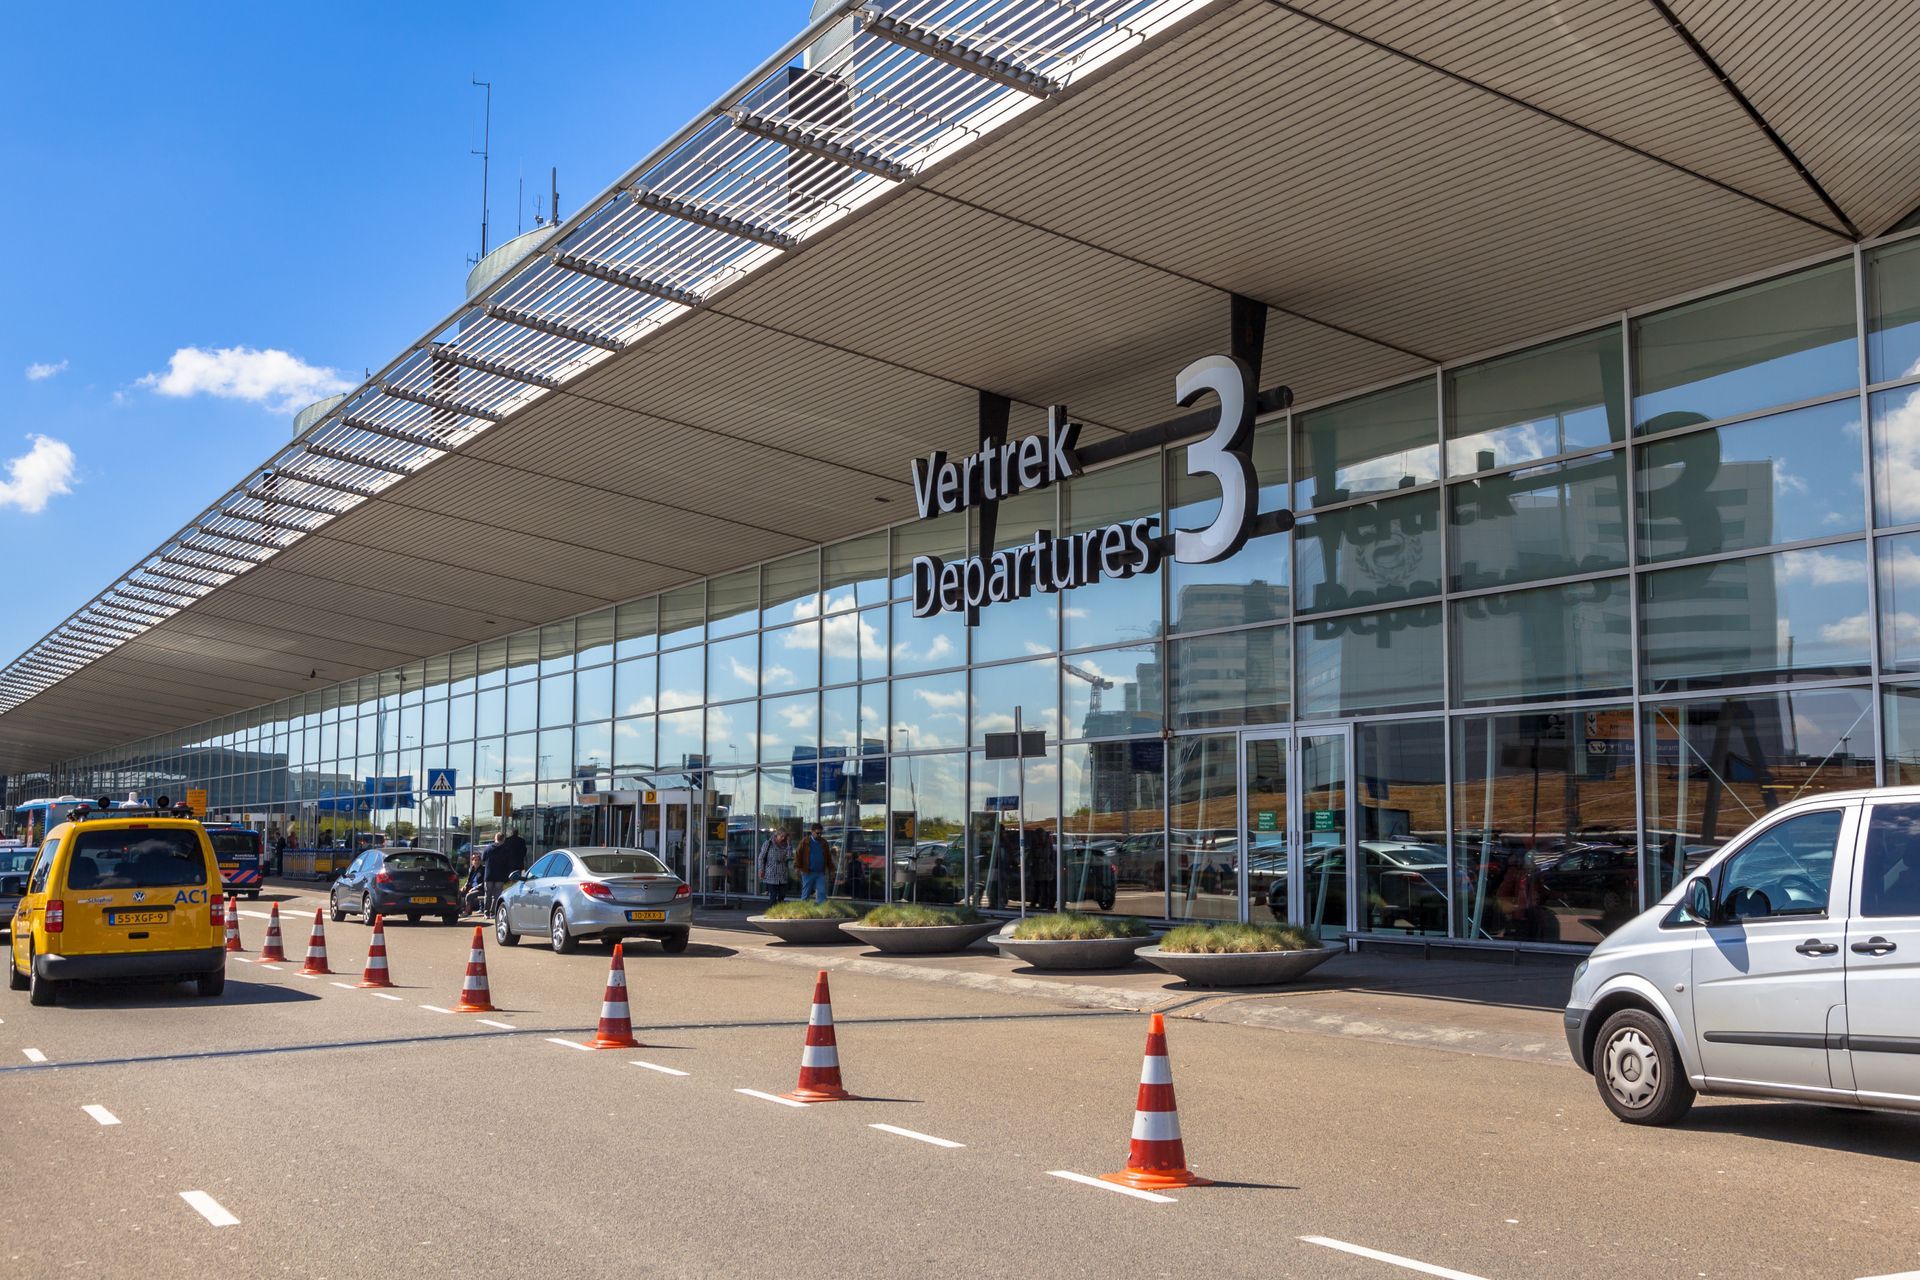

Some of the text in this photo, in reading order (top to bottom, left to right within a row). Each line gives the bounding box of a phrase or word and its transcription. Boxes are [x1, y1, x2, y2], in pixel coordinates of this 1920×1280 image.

[911, 405, 1083, 519] Vertrek
[1175, 354, 1258, 564] 3
[912, 517, 1160, 627] Departures
[647, 792, 655, 801] D
[118, 913, 164, 923] 55-XGF-9
[174, 889, 208, 904] AC1
